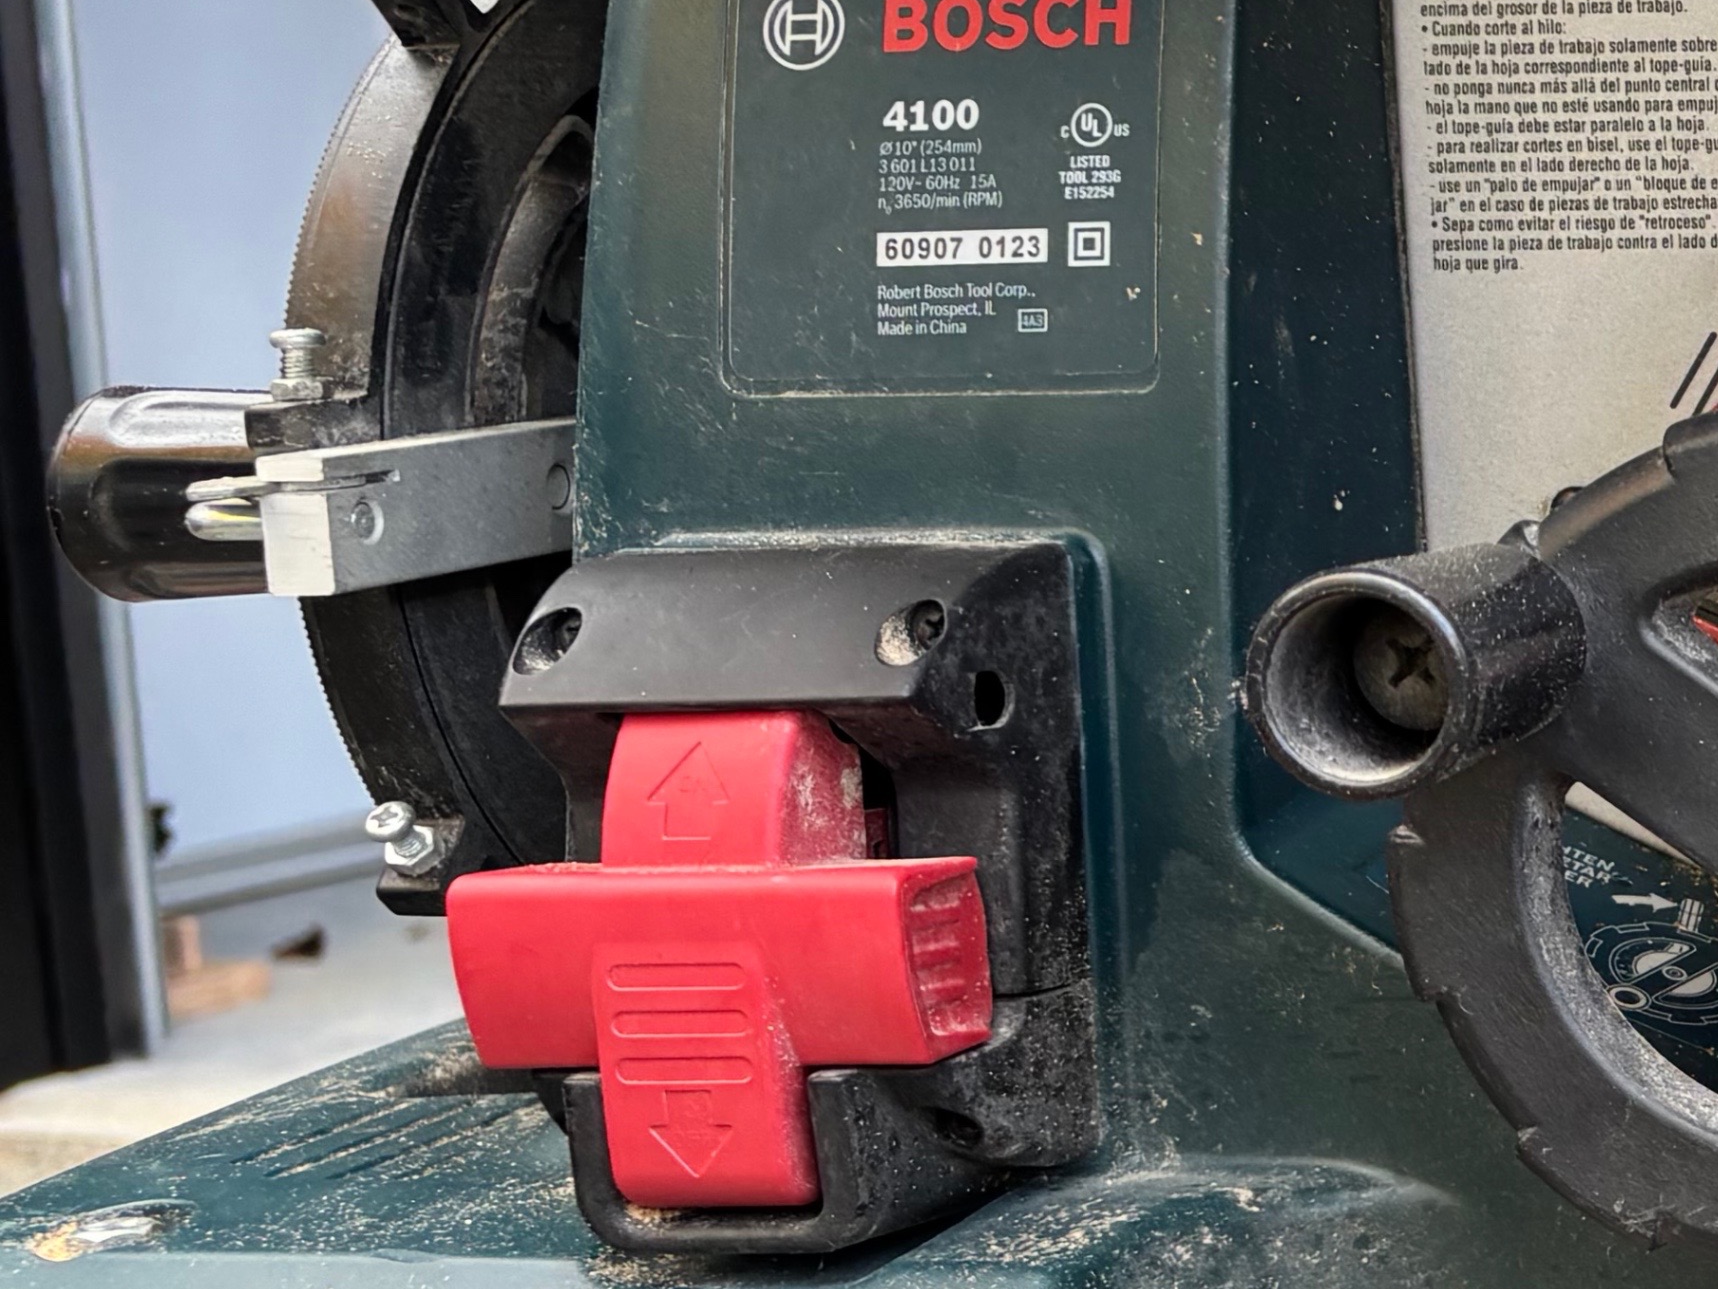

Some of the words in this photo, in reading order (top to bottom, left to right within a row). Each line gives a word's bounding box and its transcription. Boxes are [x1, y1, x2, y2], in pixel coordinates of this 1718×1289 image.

[882, 99, 979, 132] 4100
[920, 138, 982, 156] (254mm)
[1070, 155, 1111, 168] LISTED
[970, 174, 997, 189] 15A
[1058, 171, 1088, 184] TOOL
[894, 192, 961, 211] 3650/min
[963, 190, 1003, 209] (RPM)
[885, 237, 963, 260] 60907
[978, 235, 1041, 258] 0123
[1433, 256, 1461, 273] hoja
[1465, 257, 1489, 272] que
[877, 284, 921, 300] Robert
[924, 283, 963, 299] Bosch
[966, 282, 993, 298] Tool
[877, 303, 918, 318] Mount
[985, 300, 996, 315] IL
[877, 321, 913, 336] Made
[916, 320, 928, 334] in
[930, 319, 967, 334] China
